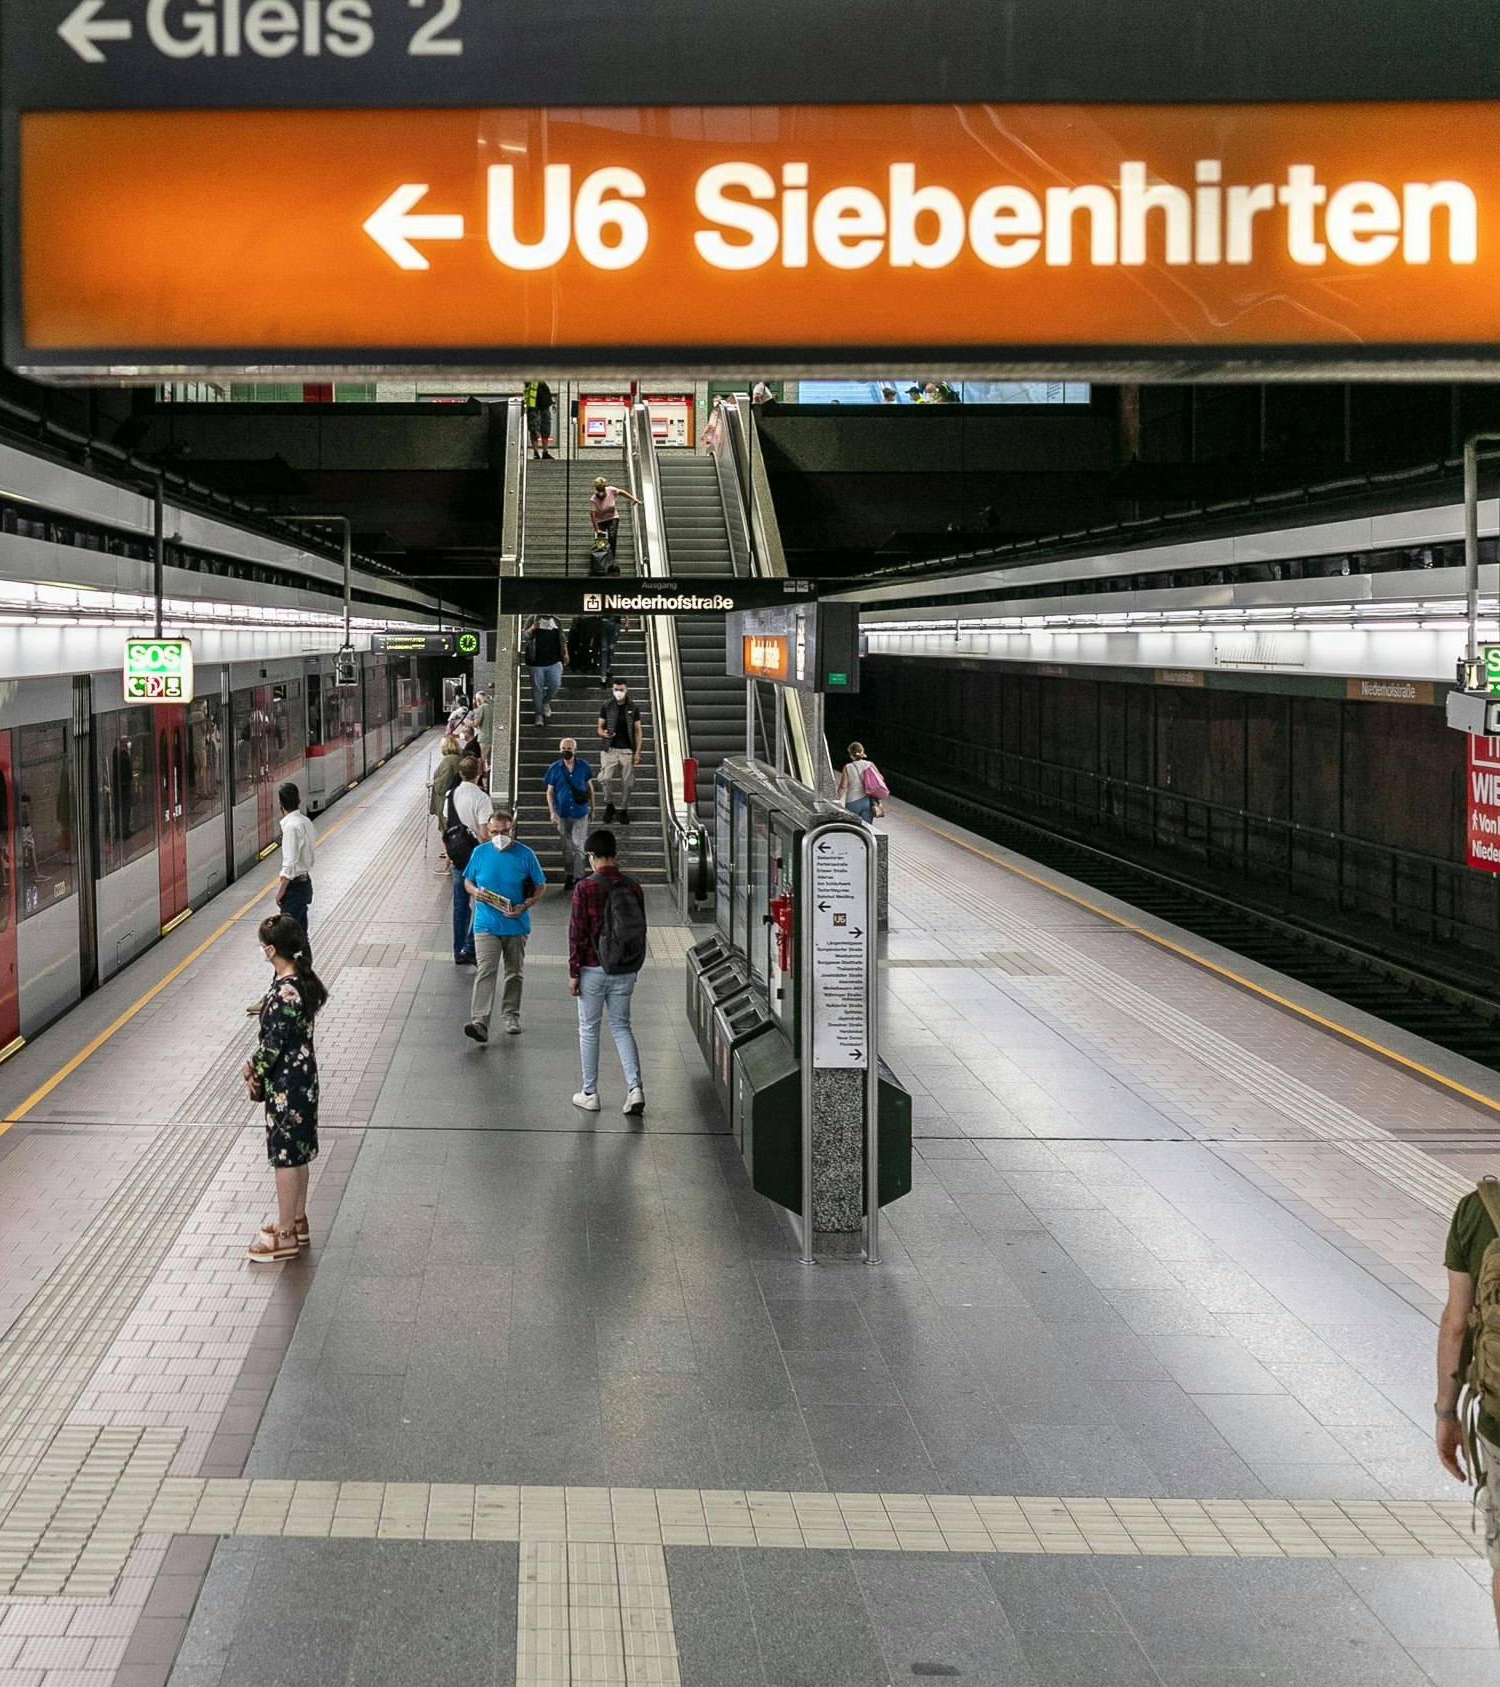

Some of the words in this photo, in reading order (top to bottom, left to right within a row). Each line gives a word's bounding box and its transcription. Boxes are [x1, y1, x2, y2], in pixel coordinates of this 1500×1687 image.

[146, 0, 375, 58] Gleis
[407, 0, 464, 56] 2
[486, 163, 649, 271] U6
[693, 159, 1478, 271] Siebenhirten
[641, 581, 677, 591] Ausgang
[604, 594, 734, 610] Niederhofstraße
[130, 645, 181, 669] SOS
[1478, 813, 1497, 834] Von
[1472, 839, 1500, 863] Niede
[834, 915, 846, 924] U6
